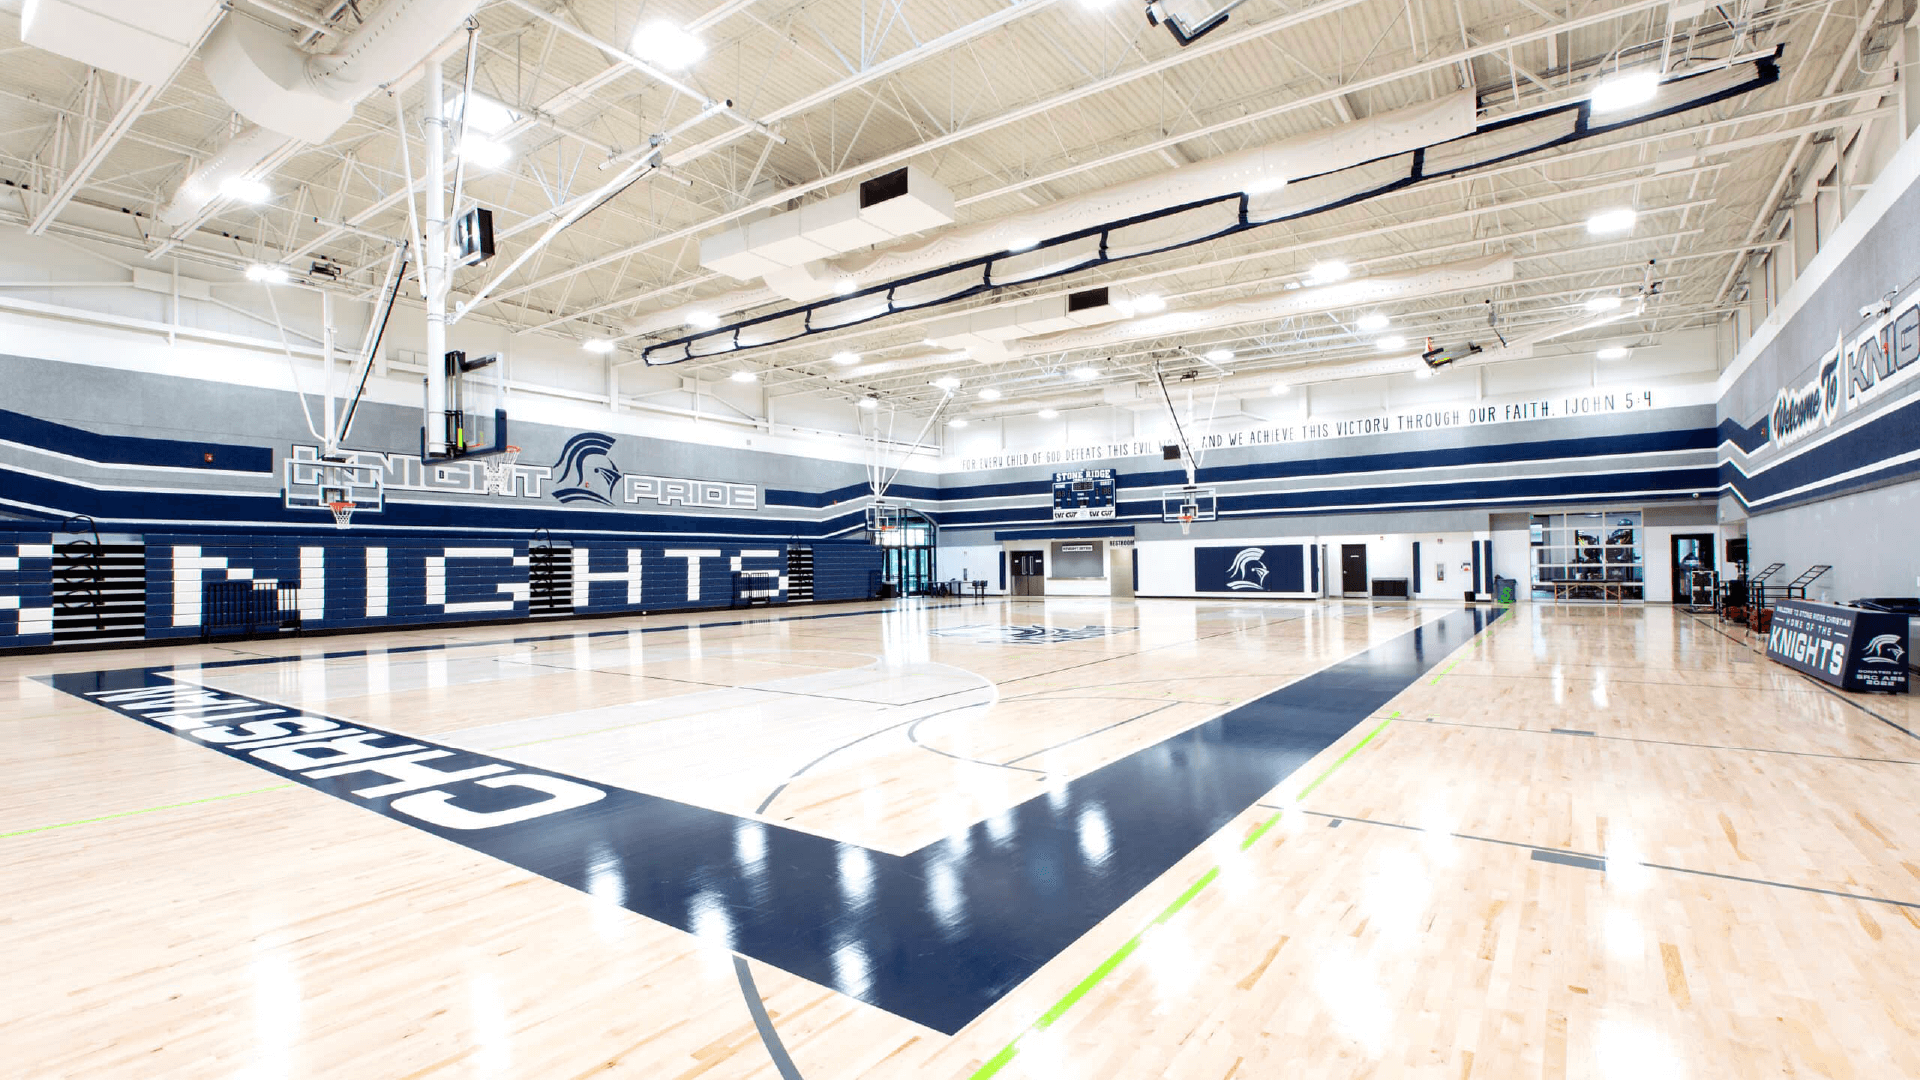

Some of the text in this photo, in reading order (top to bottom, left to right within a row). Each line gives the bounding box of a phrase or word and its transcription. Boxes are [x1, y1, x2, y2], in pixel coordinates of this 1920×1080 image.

[963, 459, 976, 470] FOR
[980, 456, 1002, 469] EVERY
[1006, 454, 1028, 467] CHILD
[1032, 452, 1041, 464] OF
[1046, 450, 1061, 463] GOD
[1065, 446, 1102, 461] DEFEATS
[1108, 443, 1128, 456] THIS
[1133, 441, 1153, 455] EVIL
[1202, 434, 1222, 449] AND
[1229, 432, 1243, 446] WE
[1250, 426, 1294, 444] ACHIEVE
[1302, 423, 1328, 439] THIS
[1336, 417, 1389, 436] VICTORY
[1398, 411, 1459, 430] THROUGH
[1469, 406, 1495, 423] OUR
[1505, 400, 1555, 421] FAITH.
[1625, 391, 1652, 409] 5:4
[1773, 386, 1822, 440] Welcome
[623, 472, 757, 511] PRIDE
[1056, 471, 1083, 482] STONE
[1086, 469, 1111, 479] RIDGE
[1786, 617, 1832, 636] HOME OF THE
[1826, 615, 1851, 628] CHRISTIAN
[1769, 625, 1845, 676] KNIGHTS
[84, 684, 607, 830] CHRISTIAN
